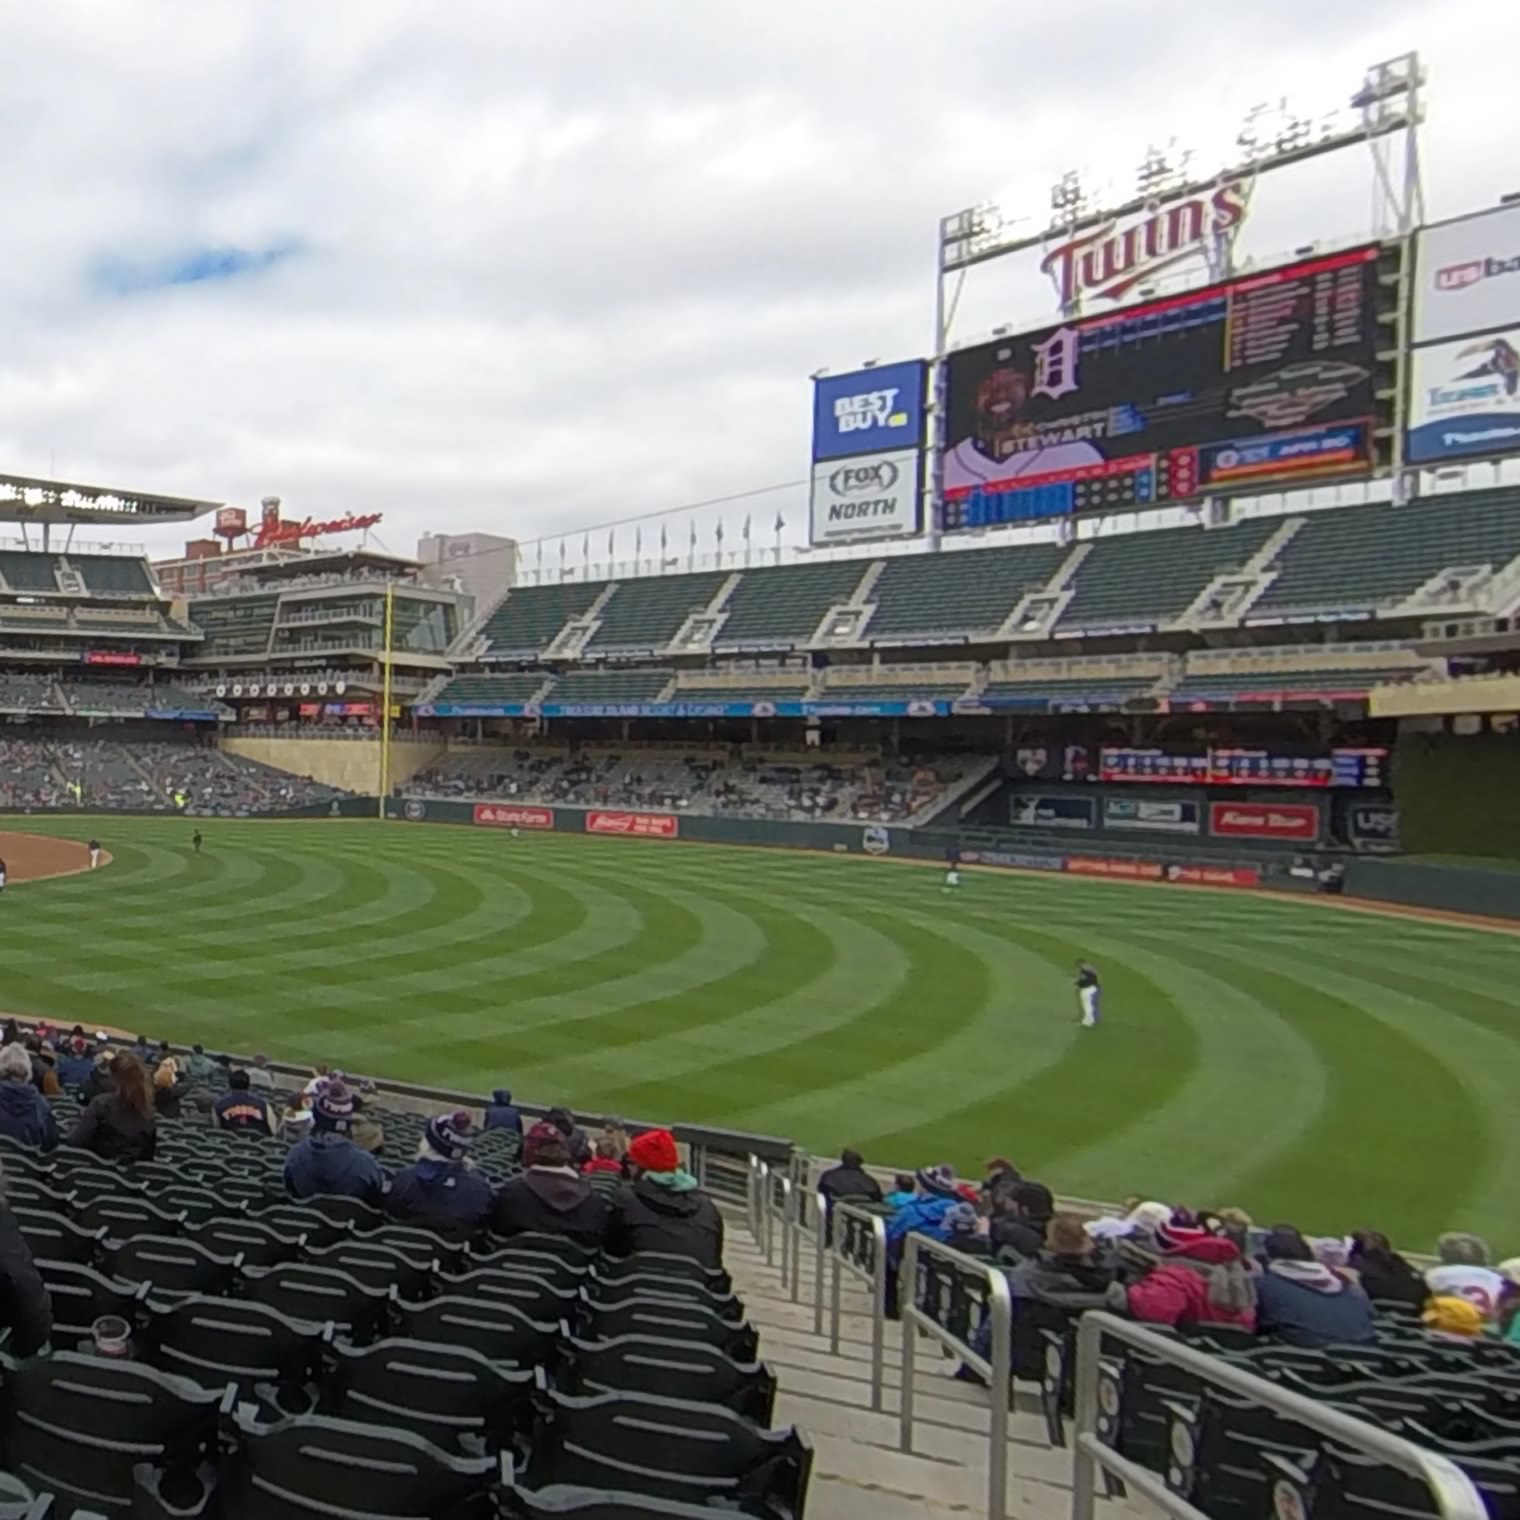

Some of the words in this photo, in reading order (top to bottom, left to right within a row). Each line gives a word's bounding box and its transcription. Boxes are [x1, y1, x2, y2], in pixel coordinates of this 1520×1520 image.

[1040, 180, 1248, 308] Twins
[834, 388, 900, 416] BEST
[838, 410, 891, 433] BUY
[1000, 422, 1106, 455] STEWART
[844, 462, 883, 485] FOX
[828, 497, 898, 522] NORTH
